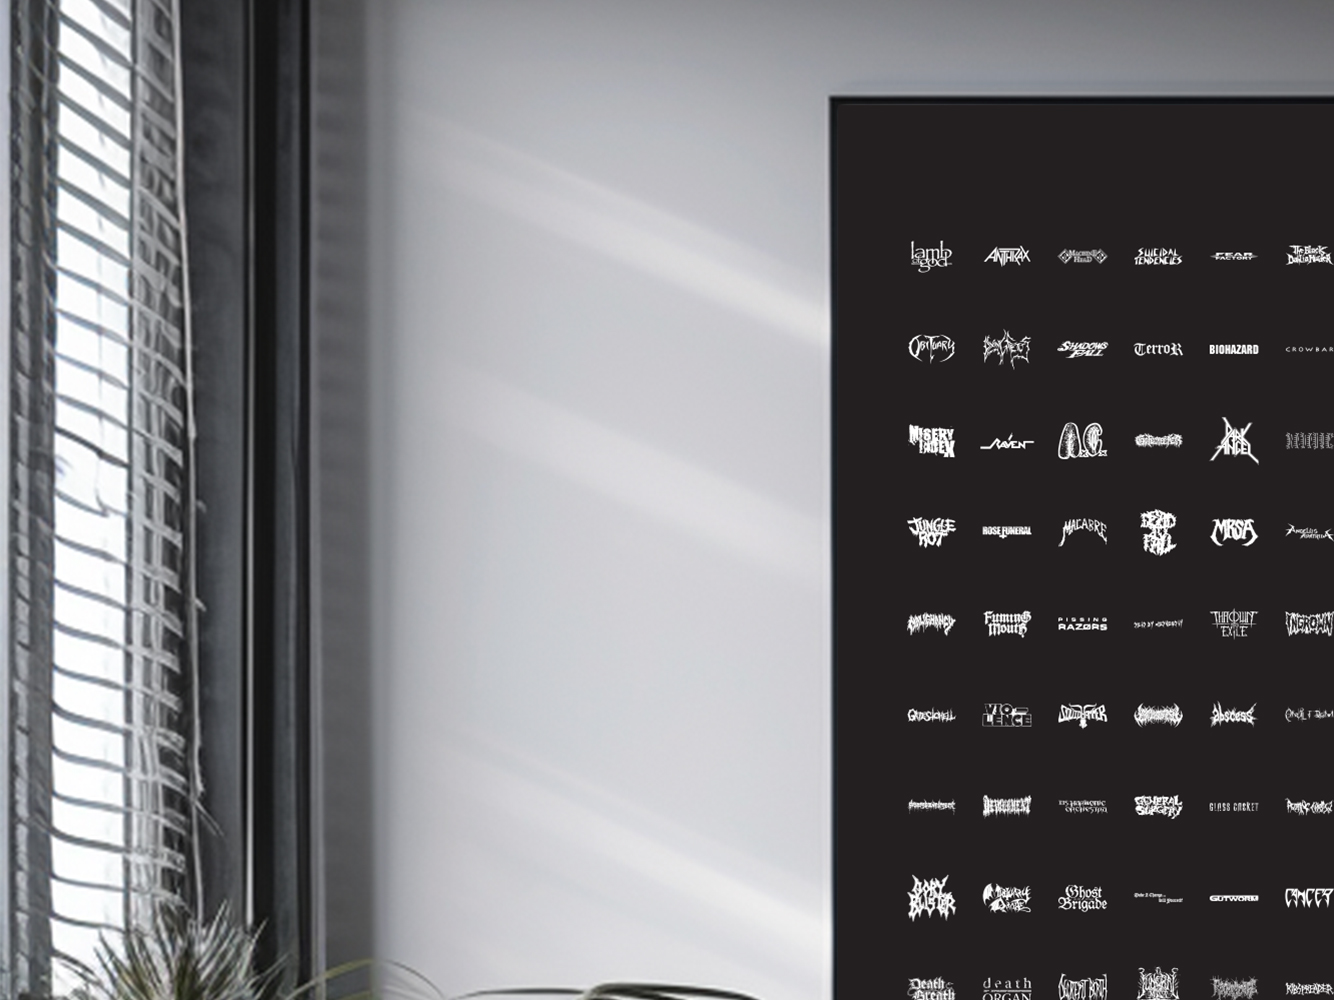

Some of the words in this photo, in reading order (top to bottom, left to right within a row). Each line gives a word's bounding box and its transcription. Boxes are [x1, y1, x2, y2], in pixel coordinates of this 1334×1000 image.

[911, 240, 952, 259] lamb
[984, 246, 1031, 267] ANTHRAX
[1138, 247, 1179, 257] SUICIDAL
[918, 258, 952, 273] god
[1134, 255, 1183, 265] TENDENCIES
[1057, 341, 1109, 351] SHADOWS
[1209, 344, 1259, 354] BIOHAZARD
[907, 517, 956, 535] JUNGLE
[982, 526, 1001, 535] ROSE
[999, 526, 1032, 538] FUNERAL
[1058, 518, 1107, 547] MACABRE
[1210, 518, 1258, 546] MRSA
[919, 532, 943, 548] ROT
[1285, 611, 1334, 636] INGROWN
[982, 713, 1032, 727] LENCE
[1134, 795, 1182, 806] GENERAL
[1135, 805, 1183, 819] SURGERY
[1065, 885, 1103, 899] Ghost
[1285, 888, 1334, 908] CANCER
[1058, 897, 1108, 913] Brigade
[908, 976, 946, 990] Death
[983, 977, 1032, 989] death
